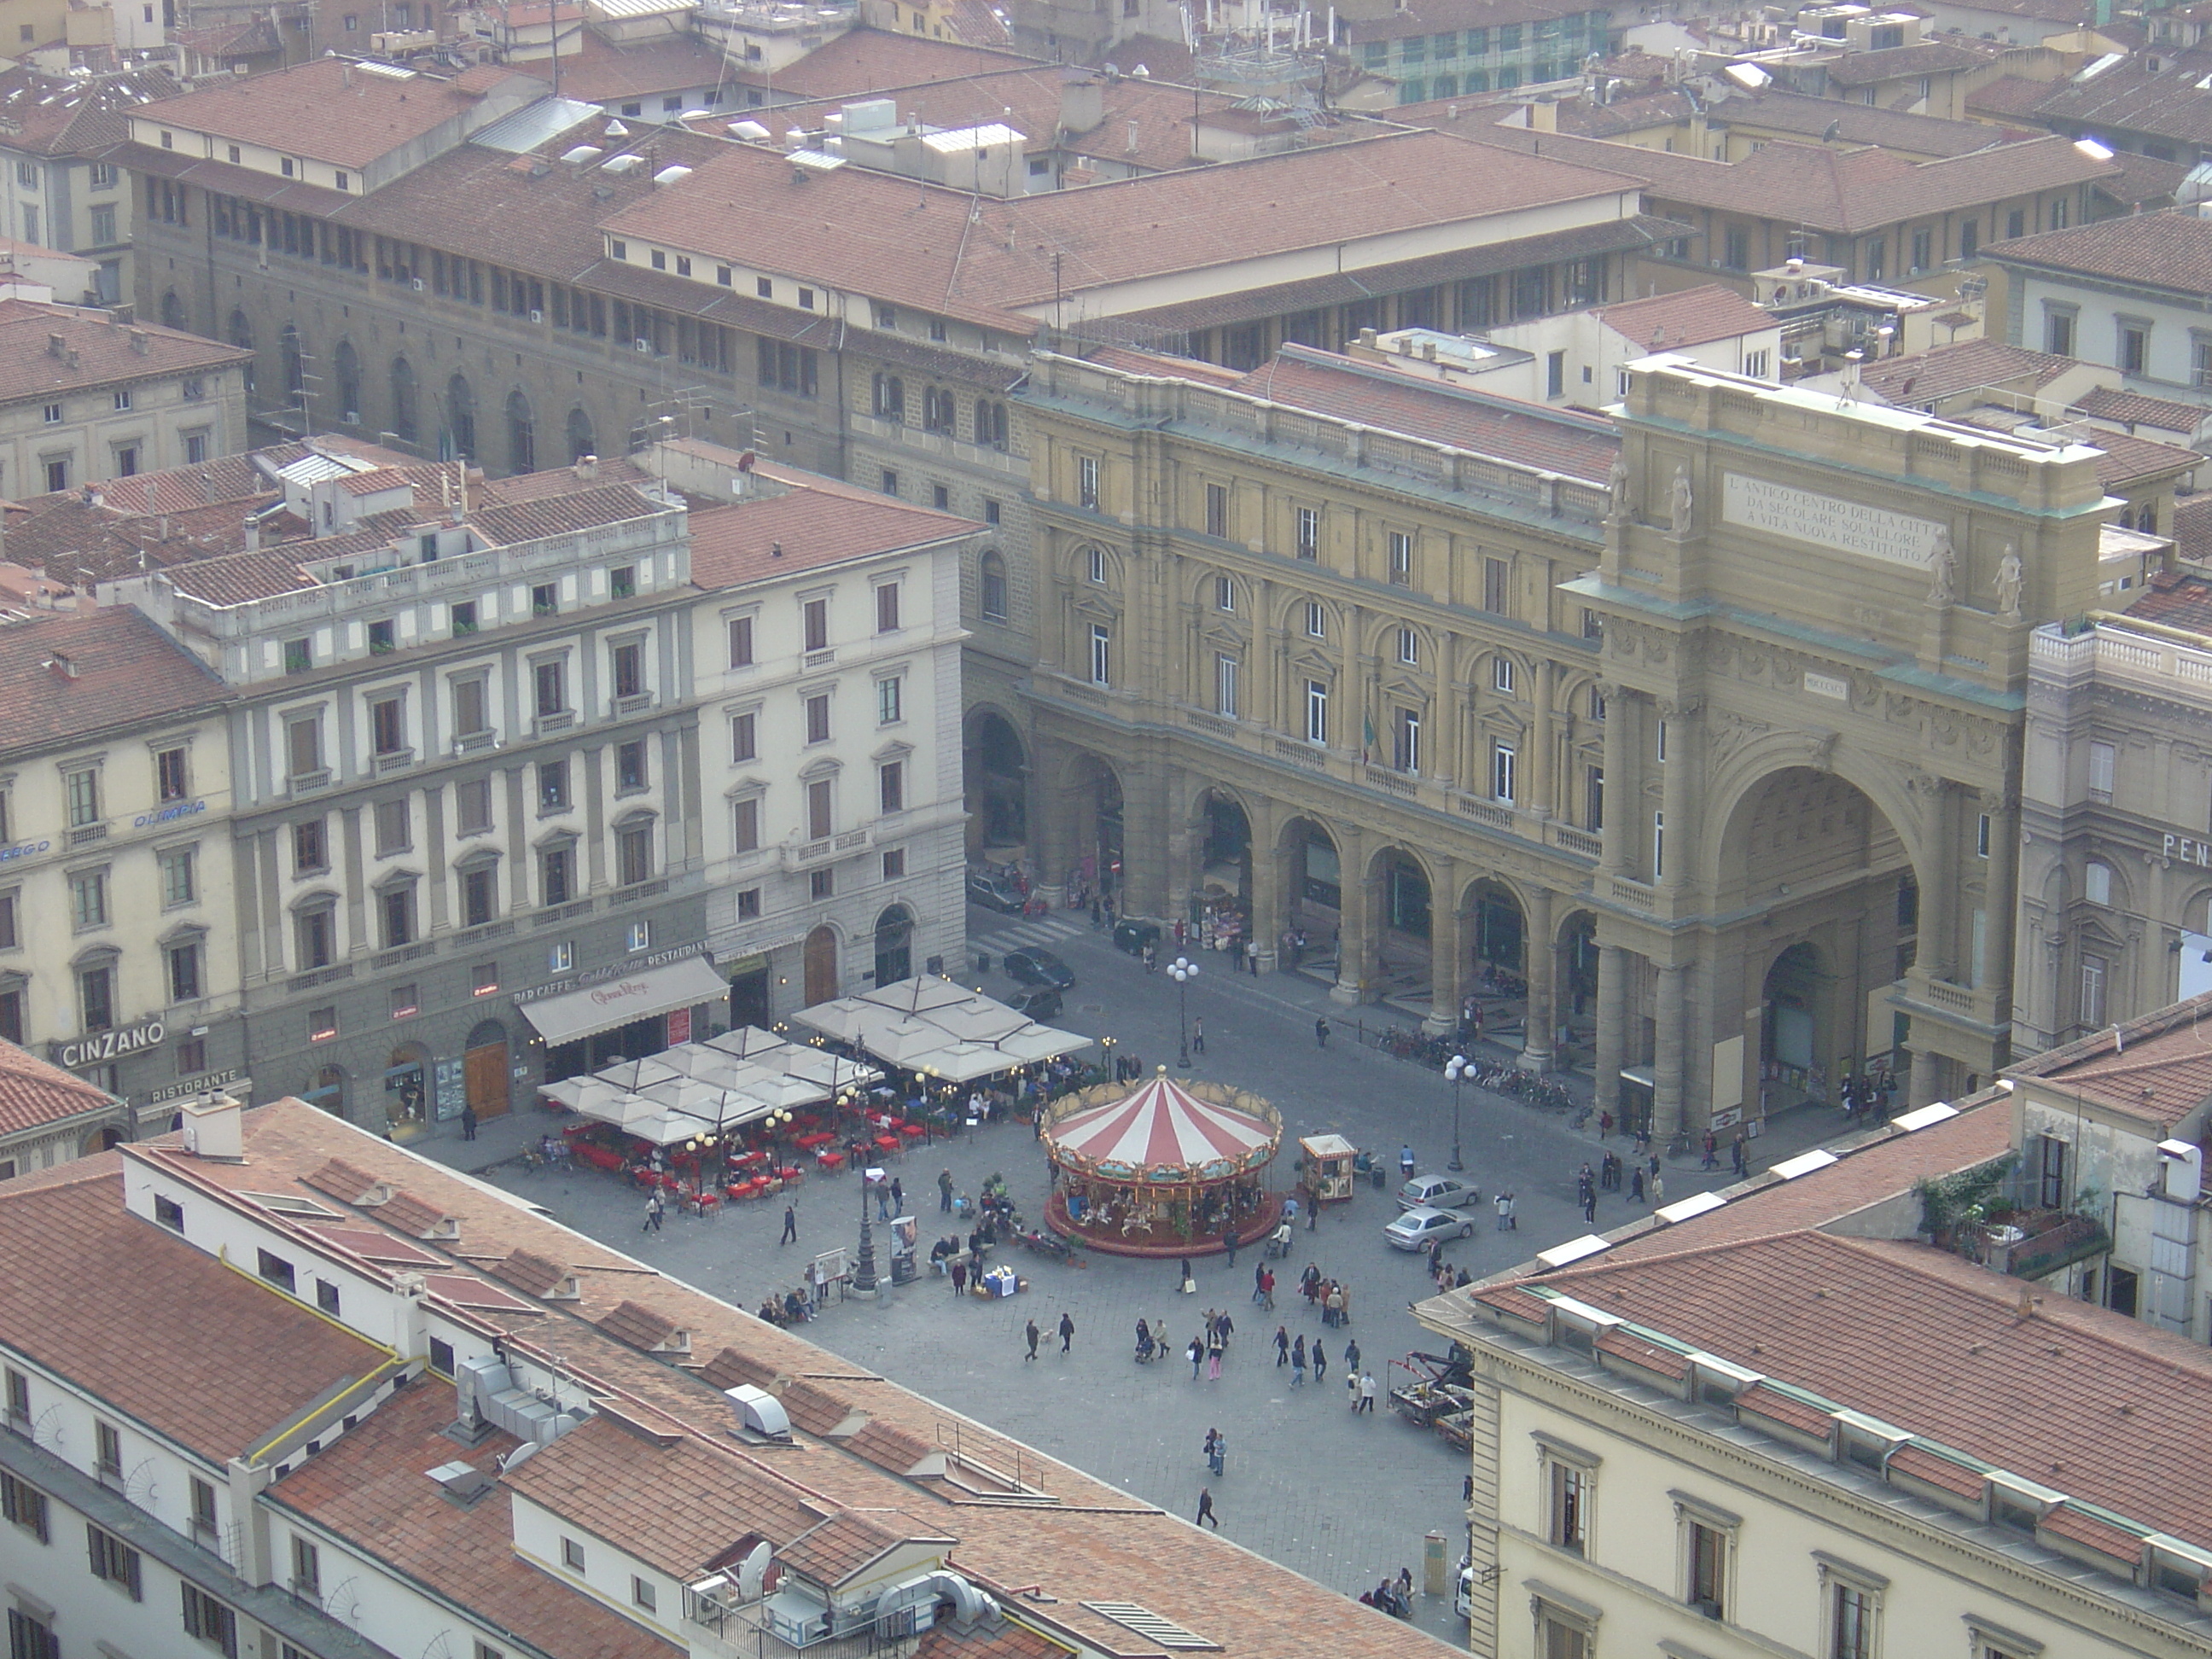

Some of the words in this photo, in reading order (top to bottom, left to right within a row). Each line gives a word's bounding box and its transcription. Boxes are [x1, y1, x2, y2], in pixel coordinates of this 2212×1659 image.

[1743, 480, 1790, 502] ANTICO
[1793, 493, 1846, 515] CENTRO
[1850, 506, 1895, 528] DELLA
[1747, 494, 1764, 509] DA
[1768, 500, 1836, 527] SECOLARE
[1842, 518, 1920, 548] SQUALLORE
[1747, 509, 1755, 522] A
[1761, 512, 1789, 530] VITA
[1795, 521, 1838, 542] NUOVA
[1842, 533, 1921, 562] RESTITUITO
[134, 800, 206, 828] OLIMPIA
[2163, 833, 2209, 868] PEN
[514, 989, 534, 1005] BAR
[648, 939, 708, 966] RESTAURANT
[62, 1022, 165, 1067] CINZANO
[152, 1068, 237, 1103] RISTORANTE
